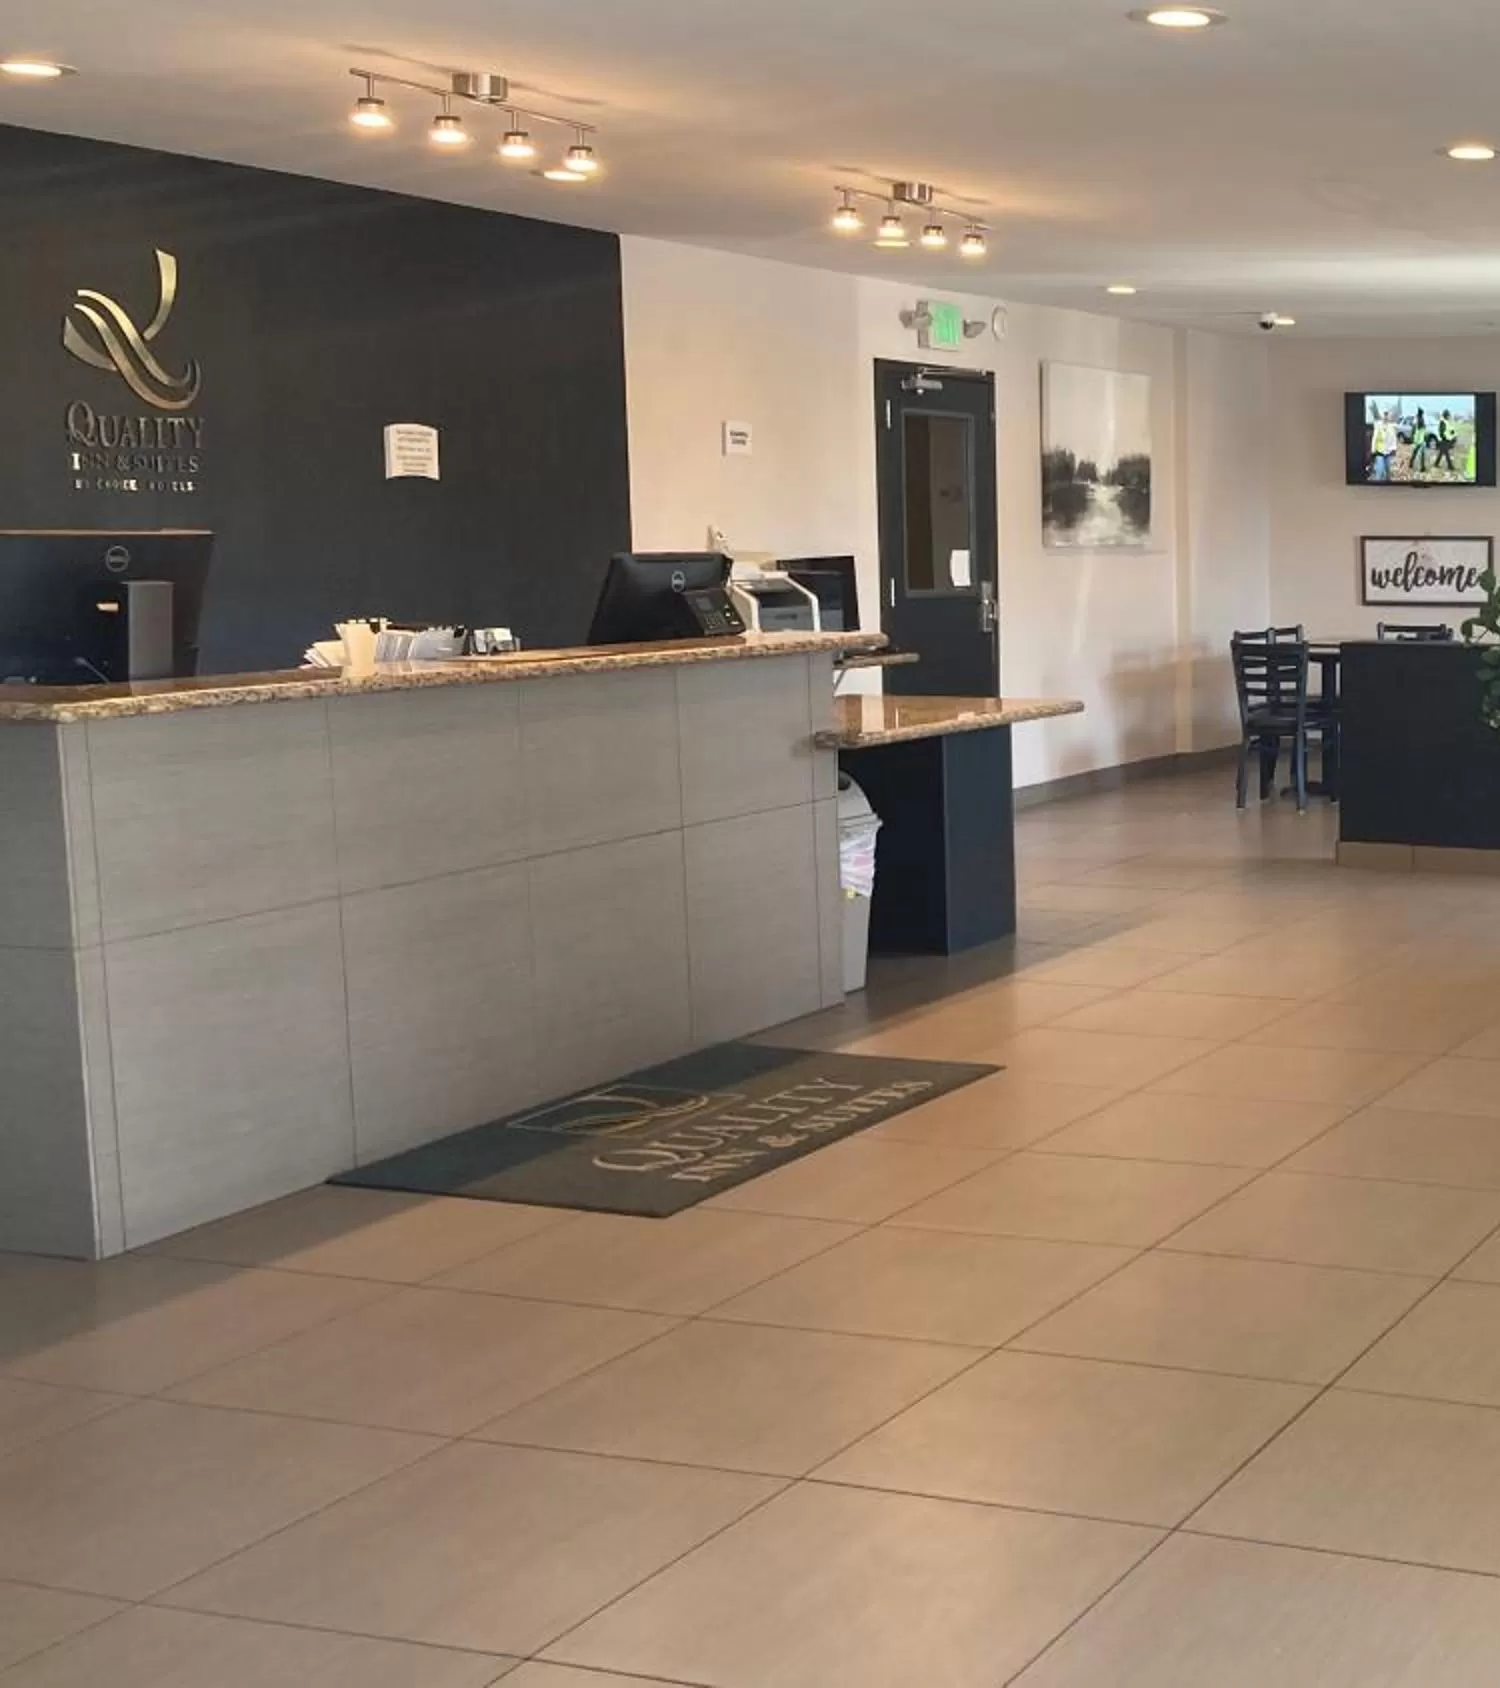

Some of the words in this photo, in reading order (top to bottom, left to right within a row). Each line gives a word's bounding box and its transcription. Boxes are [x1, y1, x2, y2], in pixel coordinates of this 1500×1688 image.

[67, 400, 206, 449] QUALITY
[1371, 551, 1481, 592] welcome
[592, 1077, 862, 1171] QUALITY
